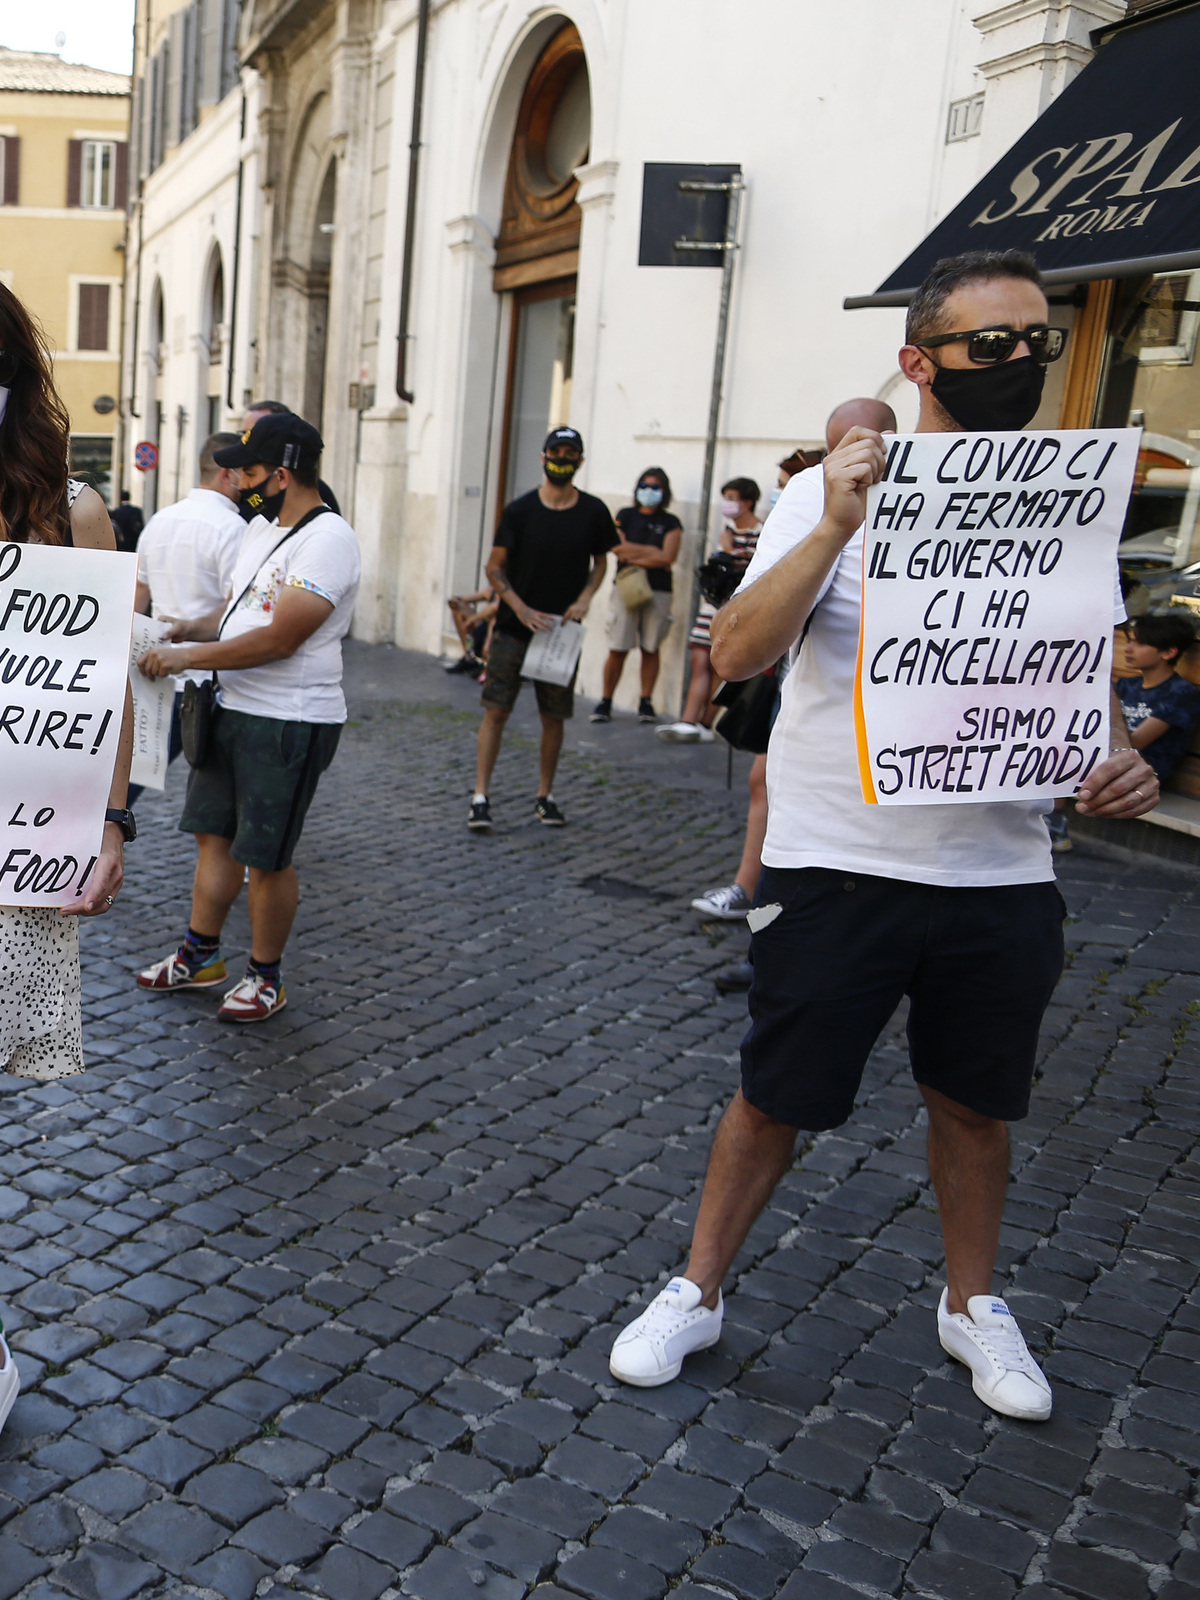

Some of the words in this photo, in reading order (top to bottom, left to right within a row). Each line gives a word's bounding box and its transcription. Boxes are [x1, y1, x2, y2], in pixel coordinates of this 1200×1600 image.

[1034, 199, 1158, 243] ROMA
[880, 441, 918, 484] IL
[937, 437, 1061, 483] COVID
[1066, 440, 1117, 481] CI
[873, 493, 925, 531] HA
[935, 487, 1105, 531] FERMATO
[868, 541, 897, 580] IL
[907, 538, 1062, 580] GOVERNO
[923, 589, 965, 630] CI
[981, 589, 1030, 630] HA
[870, 636, 1106, 686] CANCELLATO!
[956, 706, 1055, 742] SIAMO
[1064, 708, 1102, 743] LO
[876, 744, 1001, 795] STREET
[999, 743, 1101, 793] FOOD!
[8, 803, 55, 827] LO
